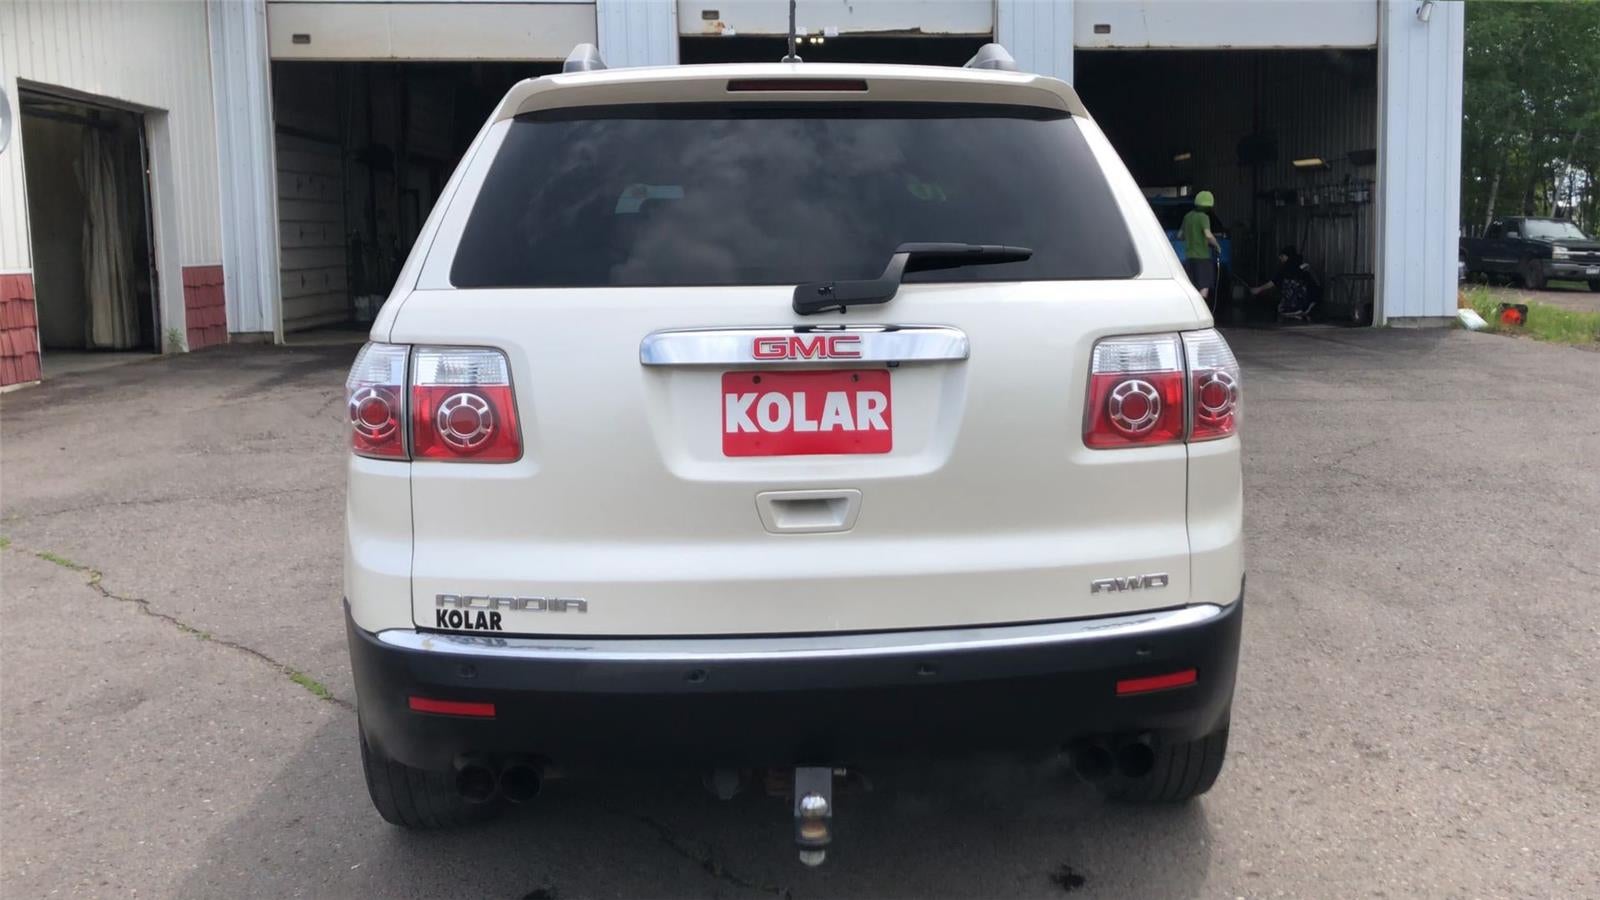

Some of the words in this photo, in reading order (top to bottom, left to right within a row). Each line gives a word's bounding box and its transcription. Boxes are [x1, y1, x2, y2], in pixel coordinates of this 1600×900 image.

[752, 335, 862, 359] GMC
[725, 391, 889, 433] KOLAR
[1091, 572, 1168, 593] AWD
[435, 594, 588, 613] ACADIA
[436, 609, 503, 630] KOLAR
